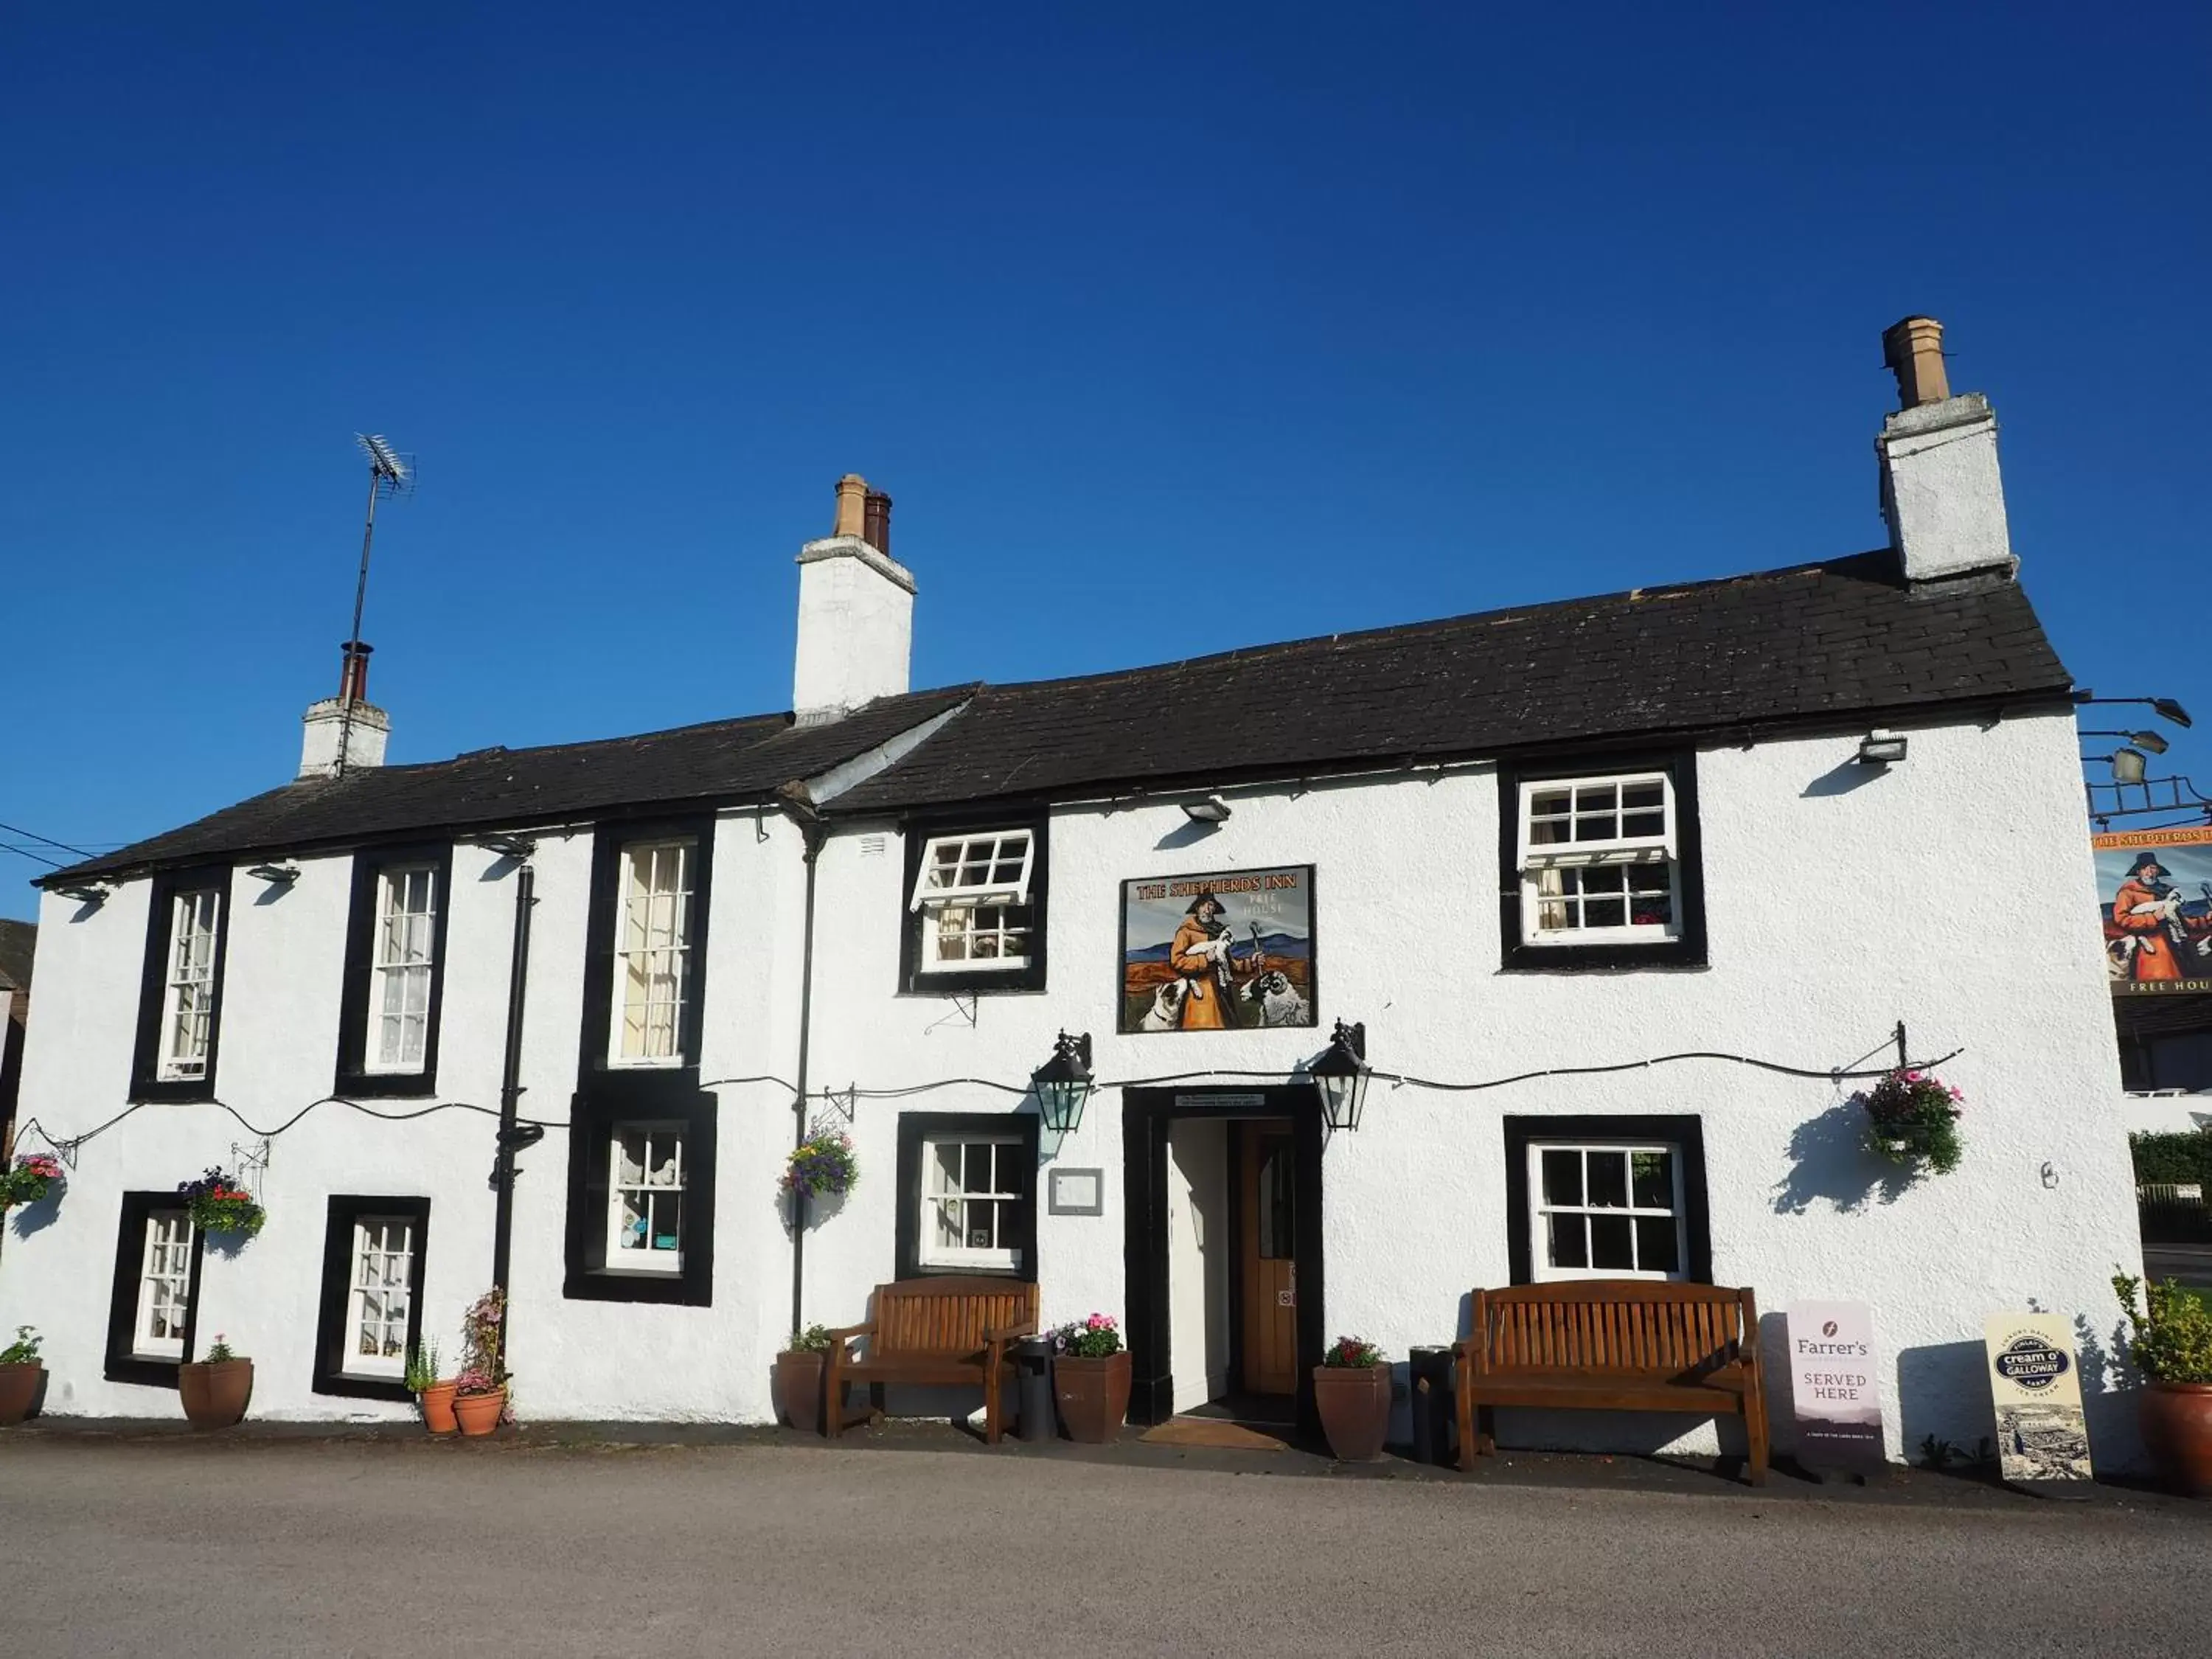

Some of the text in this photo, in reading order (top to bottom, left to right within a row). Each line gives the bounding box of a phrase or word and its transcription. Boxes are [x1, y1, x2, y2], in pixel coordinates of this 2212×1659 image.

[1136, 874, 1298, 900] THE SHEPHERDS INN
[2129, 982, 2166, 992] FREE
[1798, 1339, 1868, 1356] Farrer's
[2004, 1353, 2045, 1363] cream
[2007, 1364, 2058, 1374] GALLOWAY
[1804, 1373, 1866, 1386] SERVED
[1815, 1388, 1859, 1400] HERE
